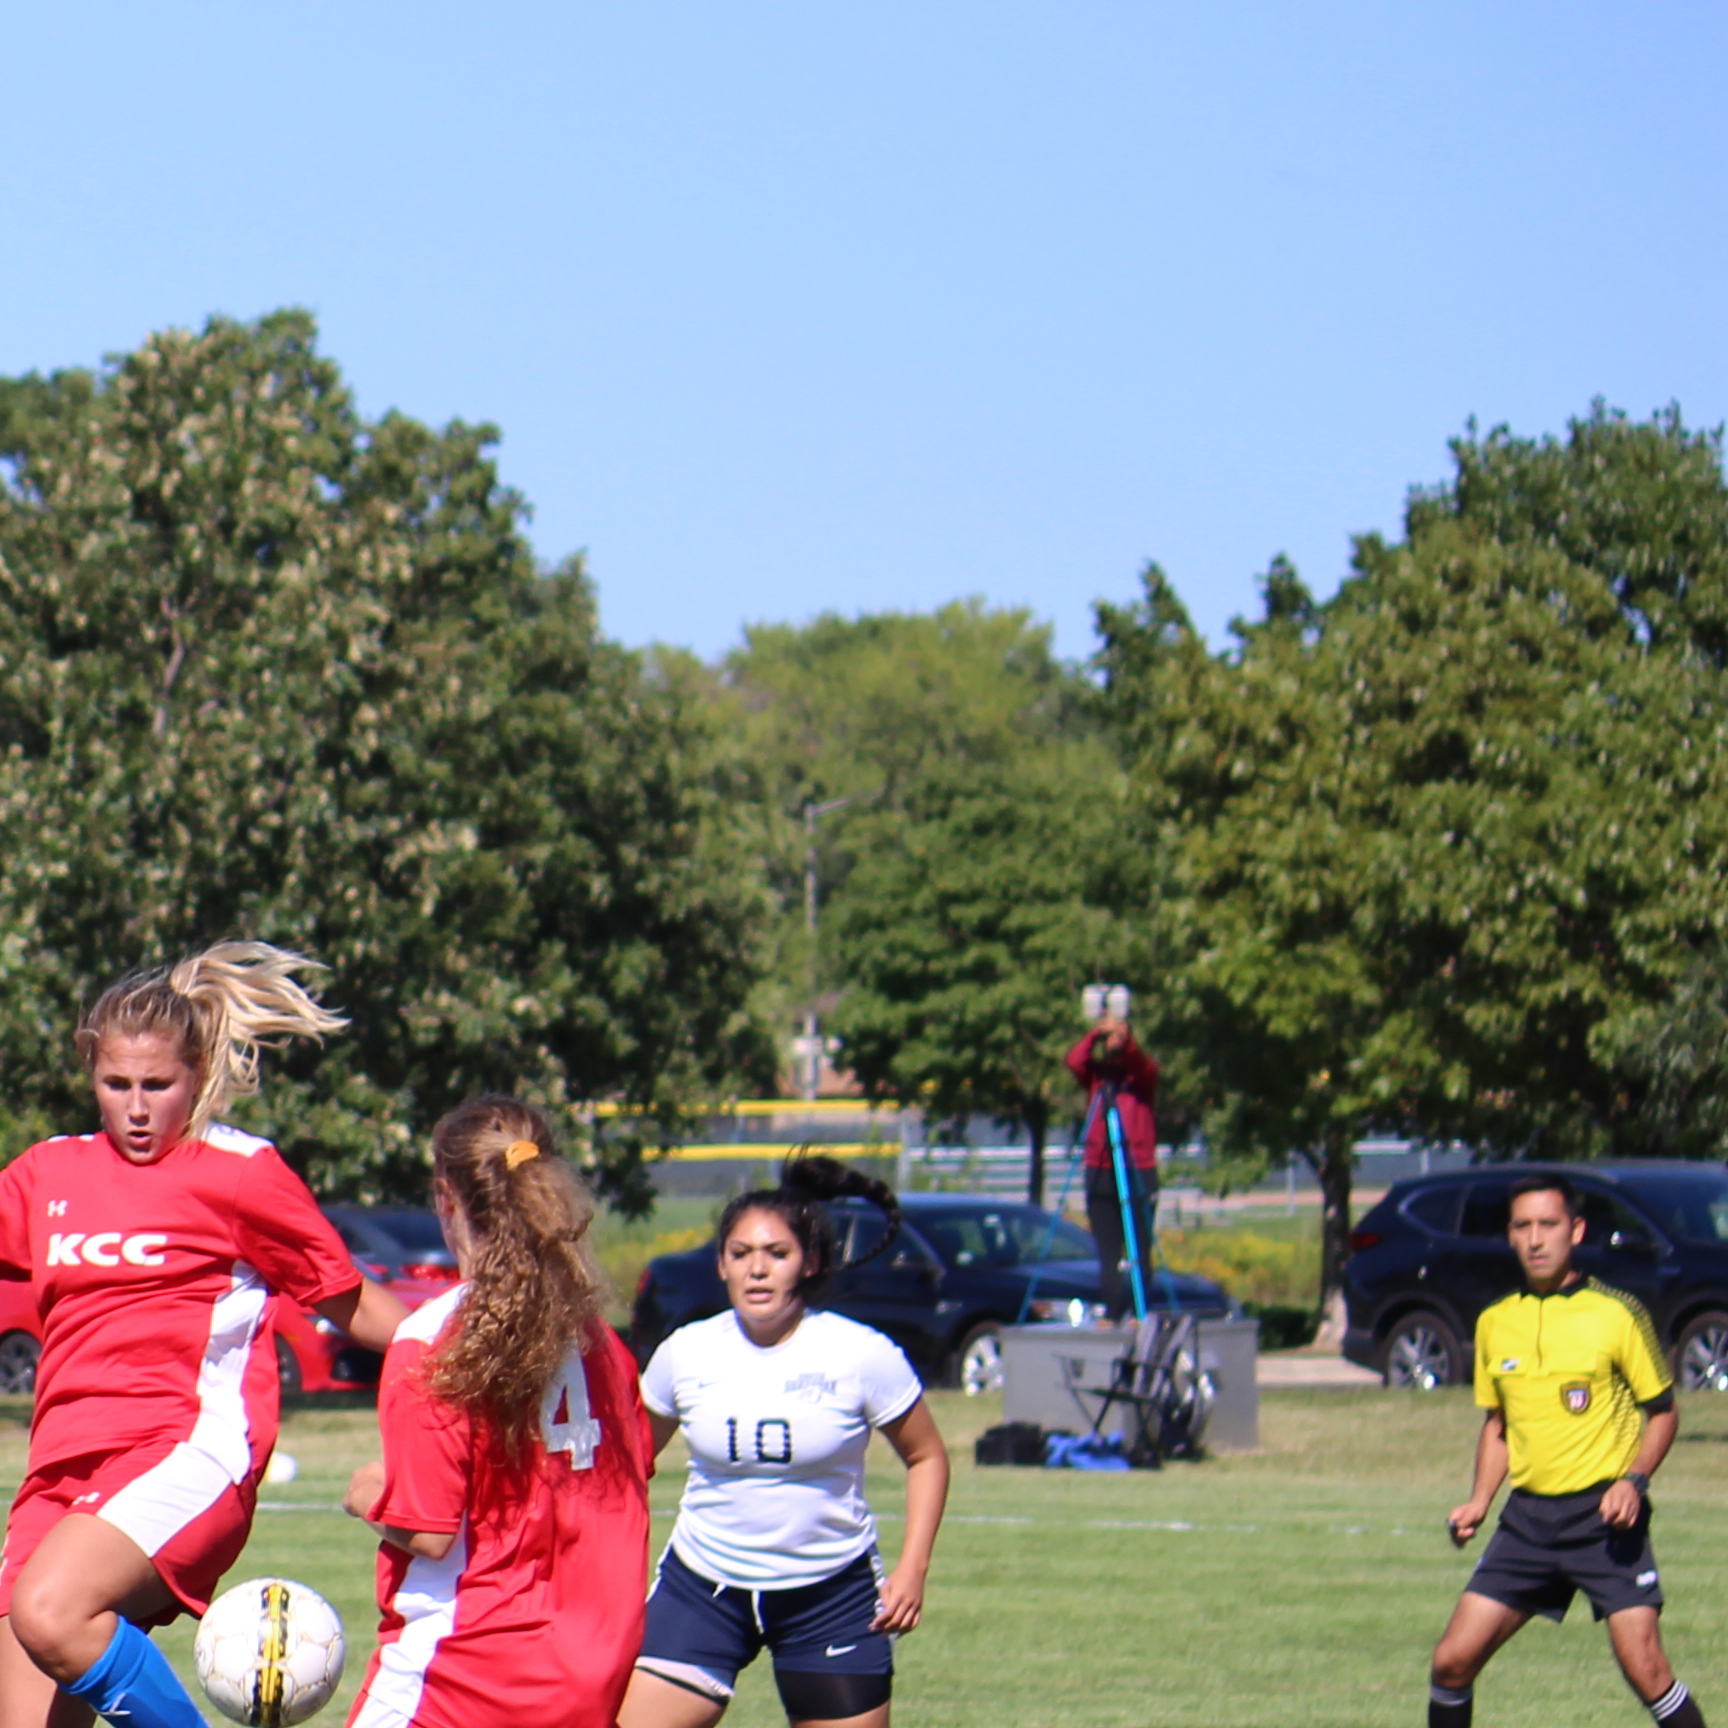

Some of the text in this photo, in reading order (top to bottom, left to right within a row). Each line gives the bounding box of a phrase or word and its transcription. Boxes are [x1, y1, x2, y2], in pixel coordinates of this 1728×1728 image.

[46, 1231, 168, 1267] KCC
[538, 1335, 601, 1471] 4
[725, 1415, 791, 1464] 10
